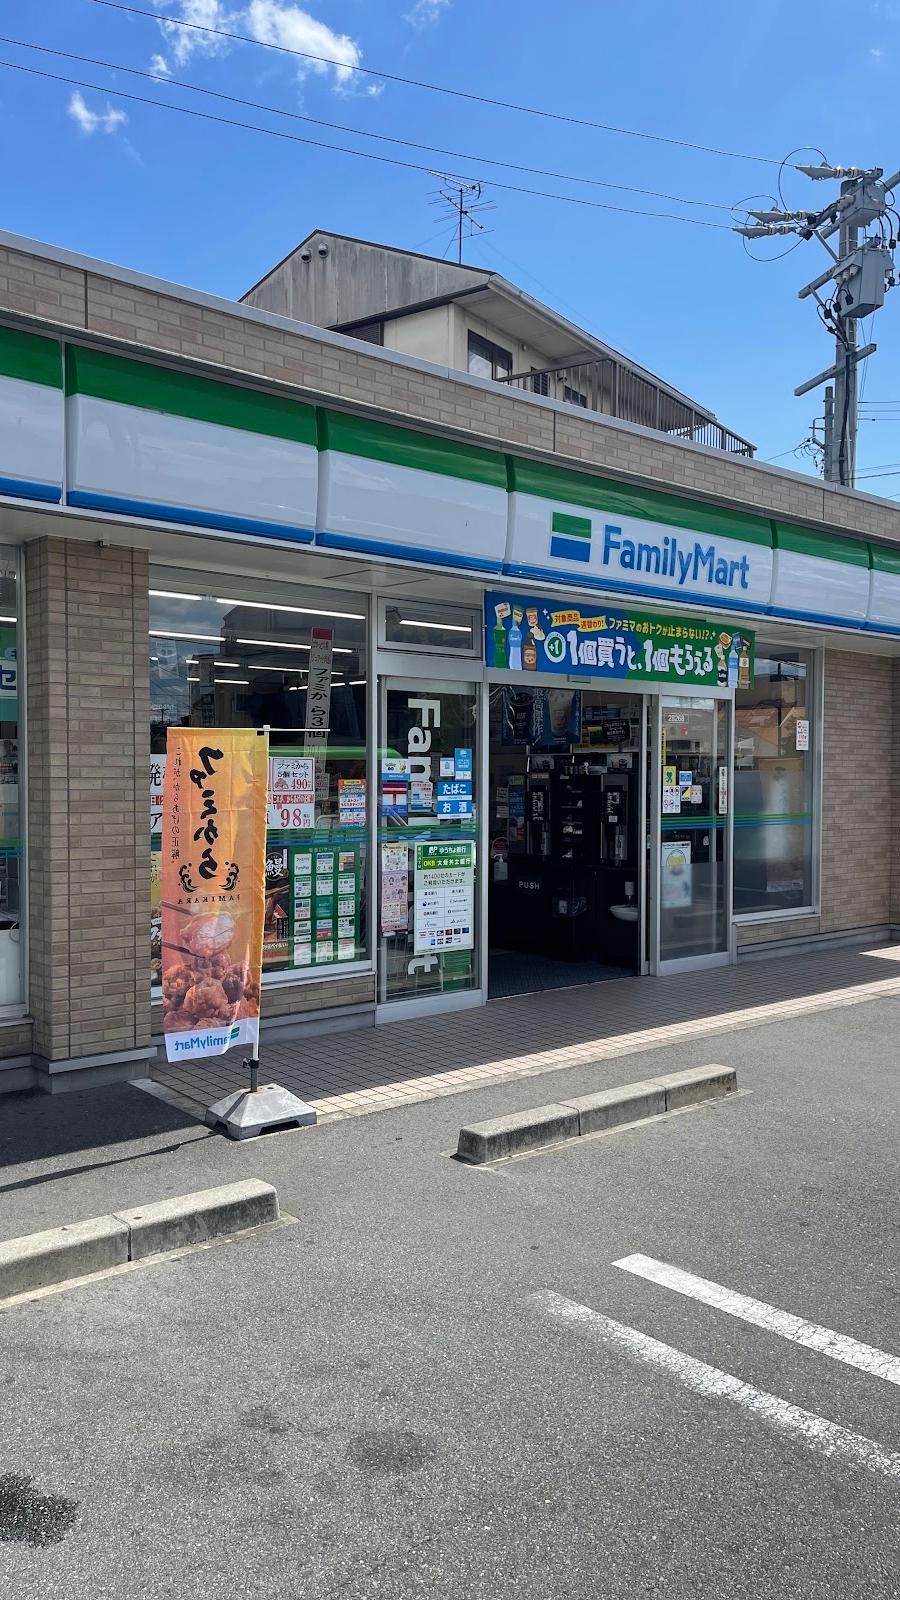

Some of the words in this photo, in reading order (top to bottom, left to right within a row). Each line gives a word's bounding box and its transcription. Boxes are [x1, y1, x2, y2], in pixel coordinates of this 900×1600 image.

[602, 524, 749, 589] FamilyMart
[291, 779, 308, 789] 490
[442, 784, 467, 794] たばこ
[281, 809, 302, 827] 98
[439, 846, 466, 854] ゆうちょ銀行
[518, 881, 540, 890] PUSH
